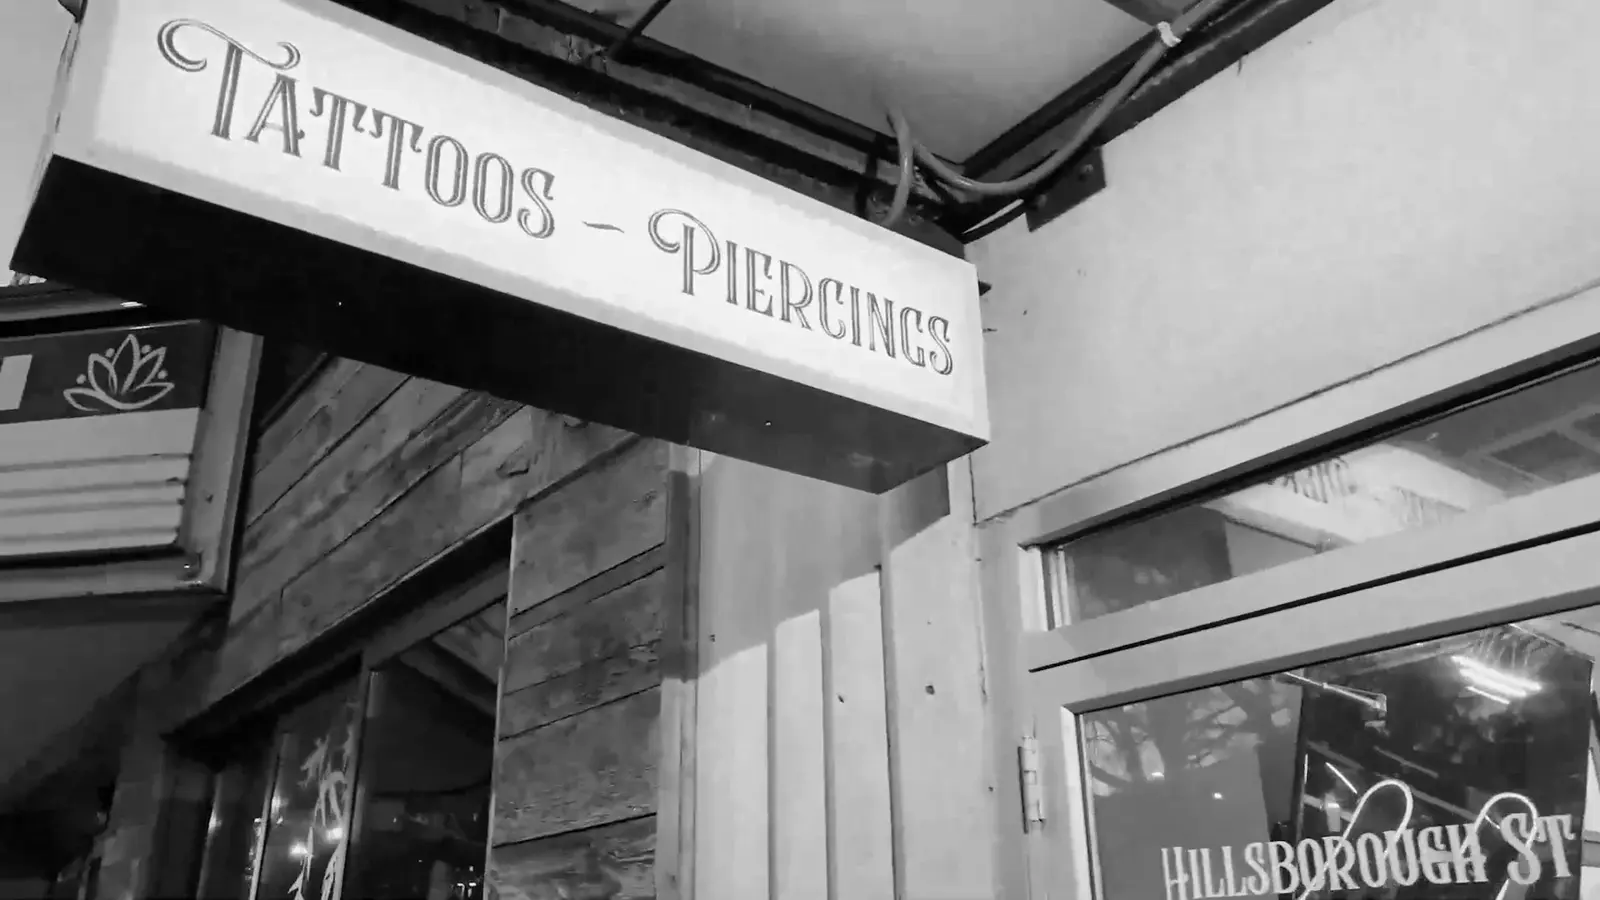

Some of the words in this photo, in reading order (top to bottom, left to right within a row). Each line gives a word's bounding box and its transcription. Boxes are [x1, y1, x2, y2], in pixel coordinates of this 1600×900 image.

[157, 18, 556, 239] TATTOOS
[647, 207, 954, 376] PIERCINGS
[1160, 822, 1489, 900] HILLSBOROUGH
[1500, 812, 1577, 886] ST
